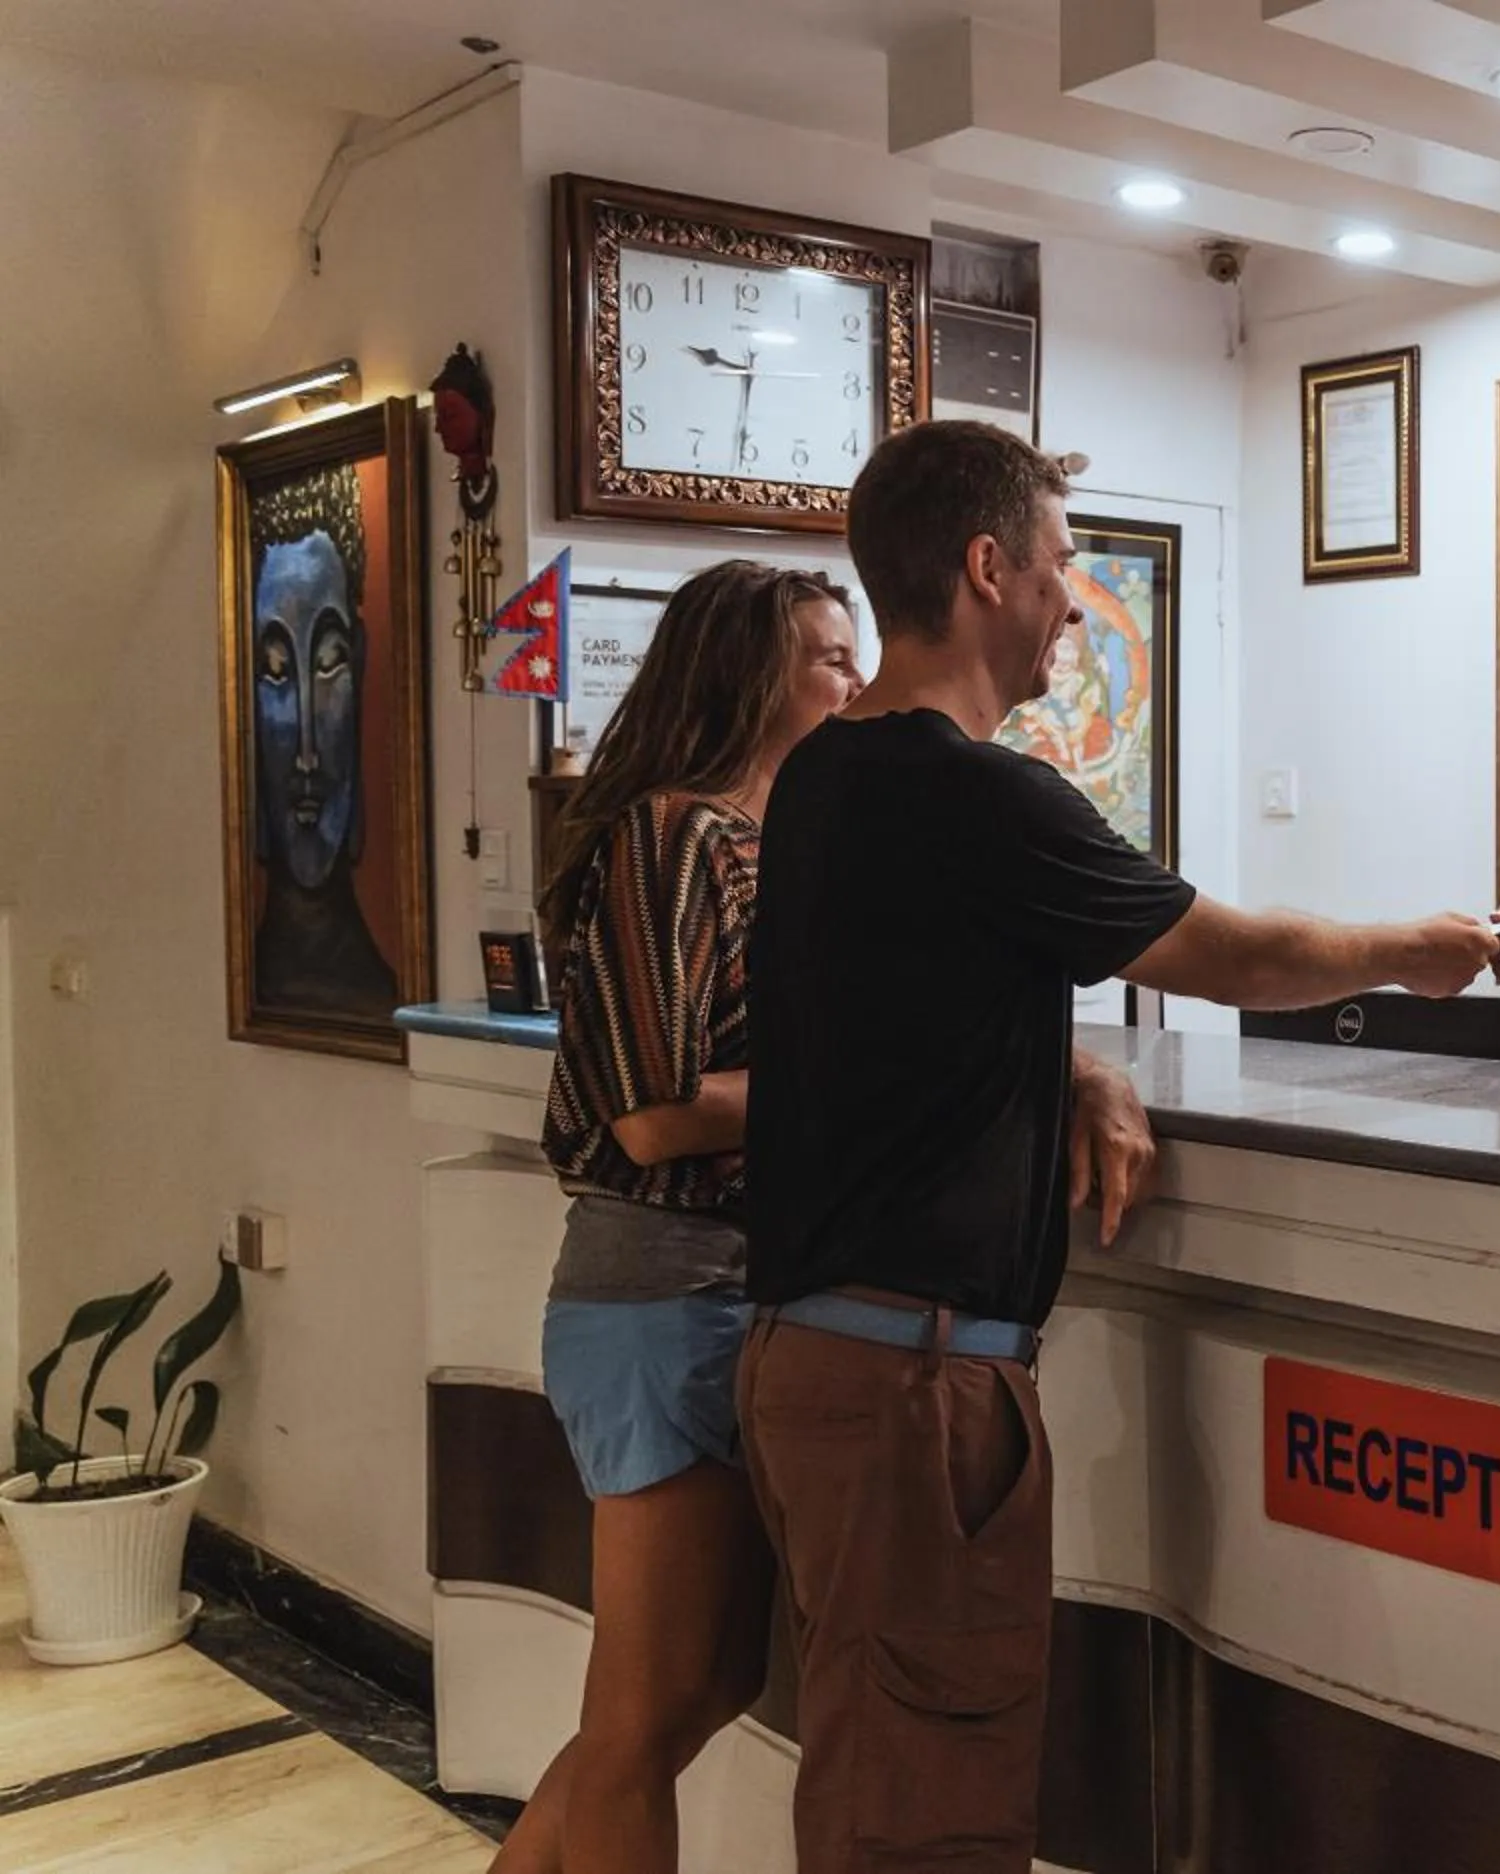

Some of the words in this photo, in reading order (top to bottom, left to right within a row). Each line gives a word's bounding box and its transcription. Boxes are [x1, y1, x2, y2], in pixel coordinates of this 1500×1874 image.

[625, 281, 654, 313] 10
[682, 275, 704, 305] 11
[734, 283, 760, 314] 12
[794, 293, 802, 321] 1
[842, 313, 861, 343] 2
[626, 344, 647, 373] 9
[842, 371, 861, 401] 3
[626, 404, 647, 435] 8
[688, 426, 704, 458] 7
[791, 438, 809, 468] 5
[841, 428, 858, 458] 4
[582, 638, 621, 652] CARD
[582, 653, 646, 667] PAYMEN
[1340, 1017, 1360, 1029] DELL
